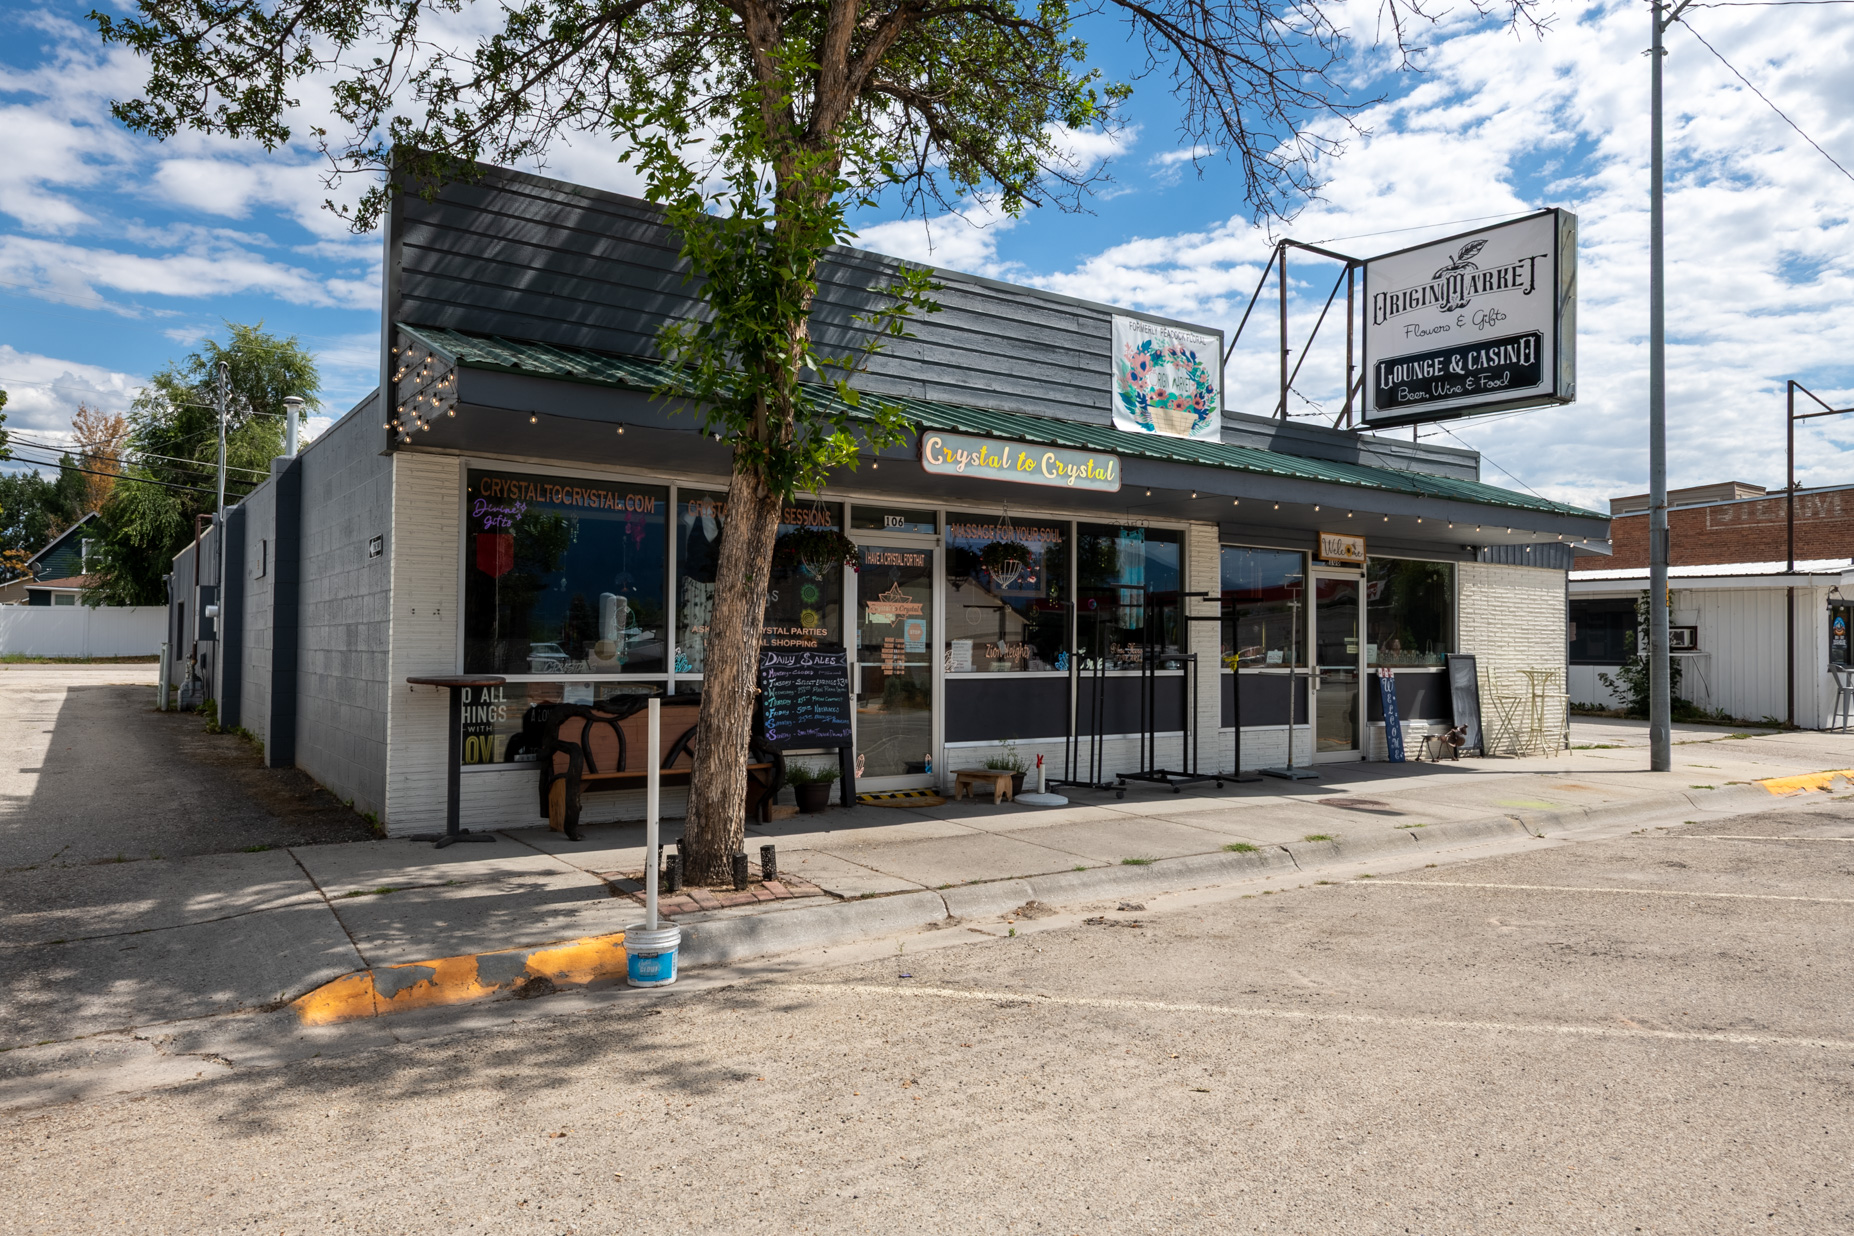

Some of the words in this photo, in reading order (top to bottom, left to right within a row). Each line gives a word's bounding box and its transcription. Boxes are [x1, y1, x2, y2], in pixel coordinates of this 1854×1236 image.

[1439, 253, 1548, 309] MARKET
[1403, 323, 1451, 338] Flowers
[1456, 314, 1466, 328] &
[1472, 308, 1507, 331] Gifts
[1380, 357, 1445, 389] LOUNGE
[1449, 354, 1465, 375] &
[1467, 336, 1535, 369] CASINO
[1398, 386, 1429, 401] Beer,
[1432, 381, 1463, 396] Wine
[1466, 376, 1476, 390] &
[1478, 371, 1510, 388] Food
[925, 436, 1012, 473] Crystal
[1016, 451, 1037, 471] to
[1041, 452, 1115, 486] Crystal
[480, 477, 655, 513] CRYSTALTOCRYSTAL.COM
[688, 499, 727, 519] CRYSTA
[784, 507, 832, 527] SESSIONS
[886, 516, 904, 527] 106
[951, 522, 994, 539] MASSAGE
[996, 525, 1014, 540] FOR
[1015, 526, 1038, 542] YOUR
[1040, 527, 1062, 543] SOUL
[884, 552, 904, 566] CRYSTAL
[760, 627, 789, 635] YSTAL
[791, 627, 828, 637] PARTIES
[771, 638, 818, 648] SHOPPING
[480, 687, 507, 703] ALL
[462, 705, 507, 724] HINGS
[1381, 677, 1400, 760] WELCOME
[467, 725, 493, 733] WITH
[465, 735, 506, 764] OVE
